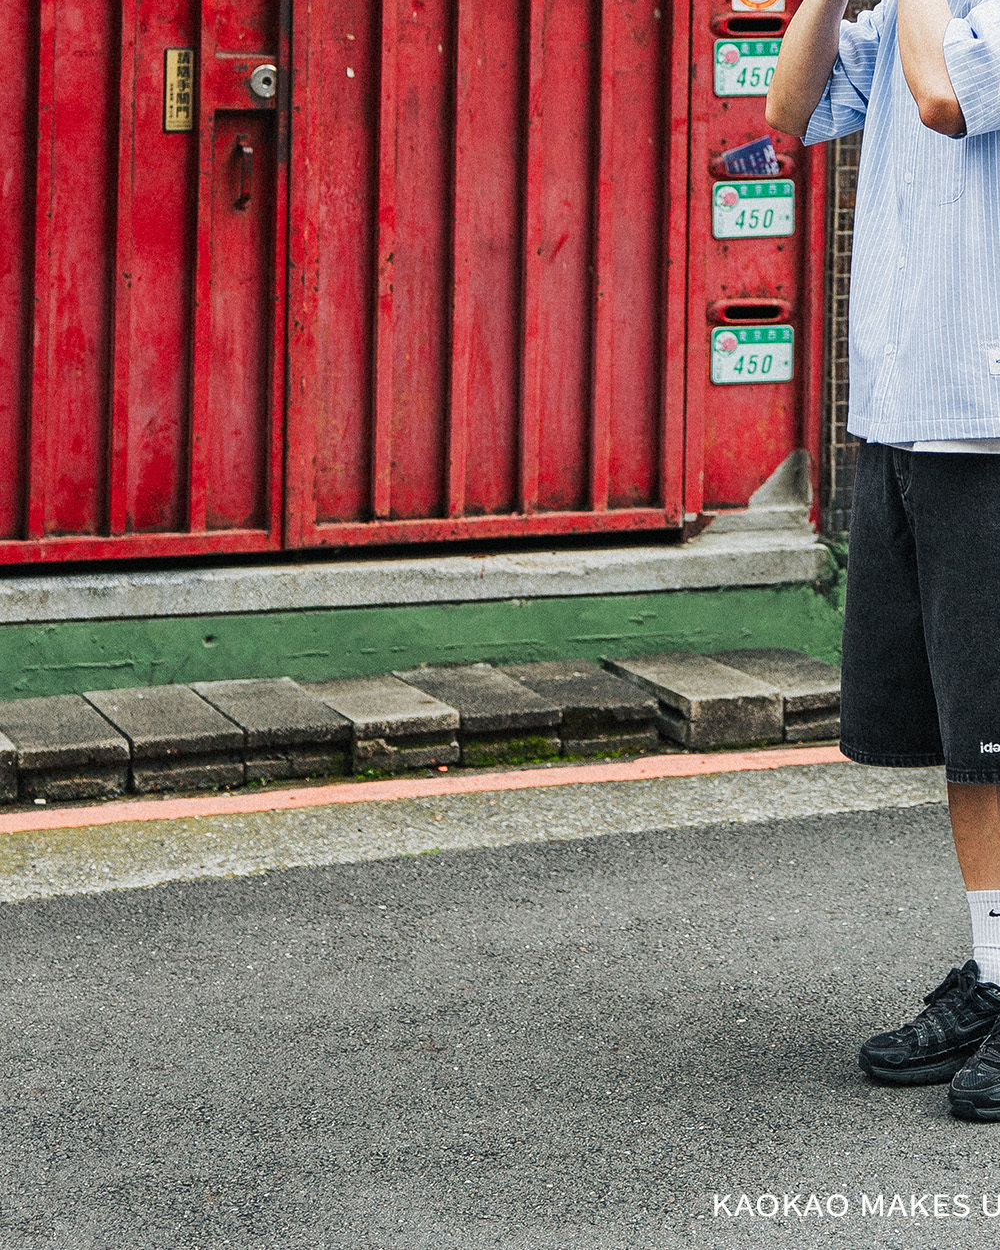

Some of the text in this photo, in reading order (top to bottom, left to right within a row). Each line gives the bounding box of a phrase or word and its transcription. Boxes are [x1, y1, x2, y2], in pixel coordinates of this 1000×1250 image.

[737, 67, 775, 88] 450
[735, 208, 774, 230] 450
[733, 354, 773, 375] 450
